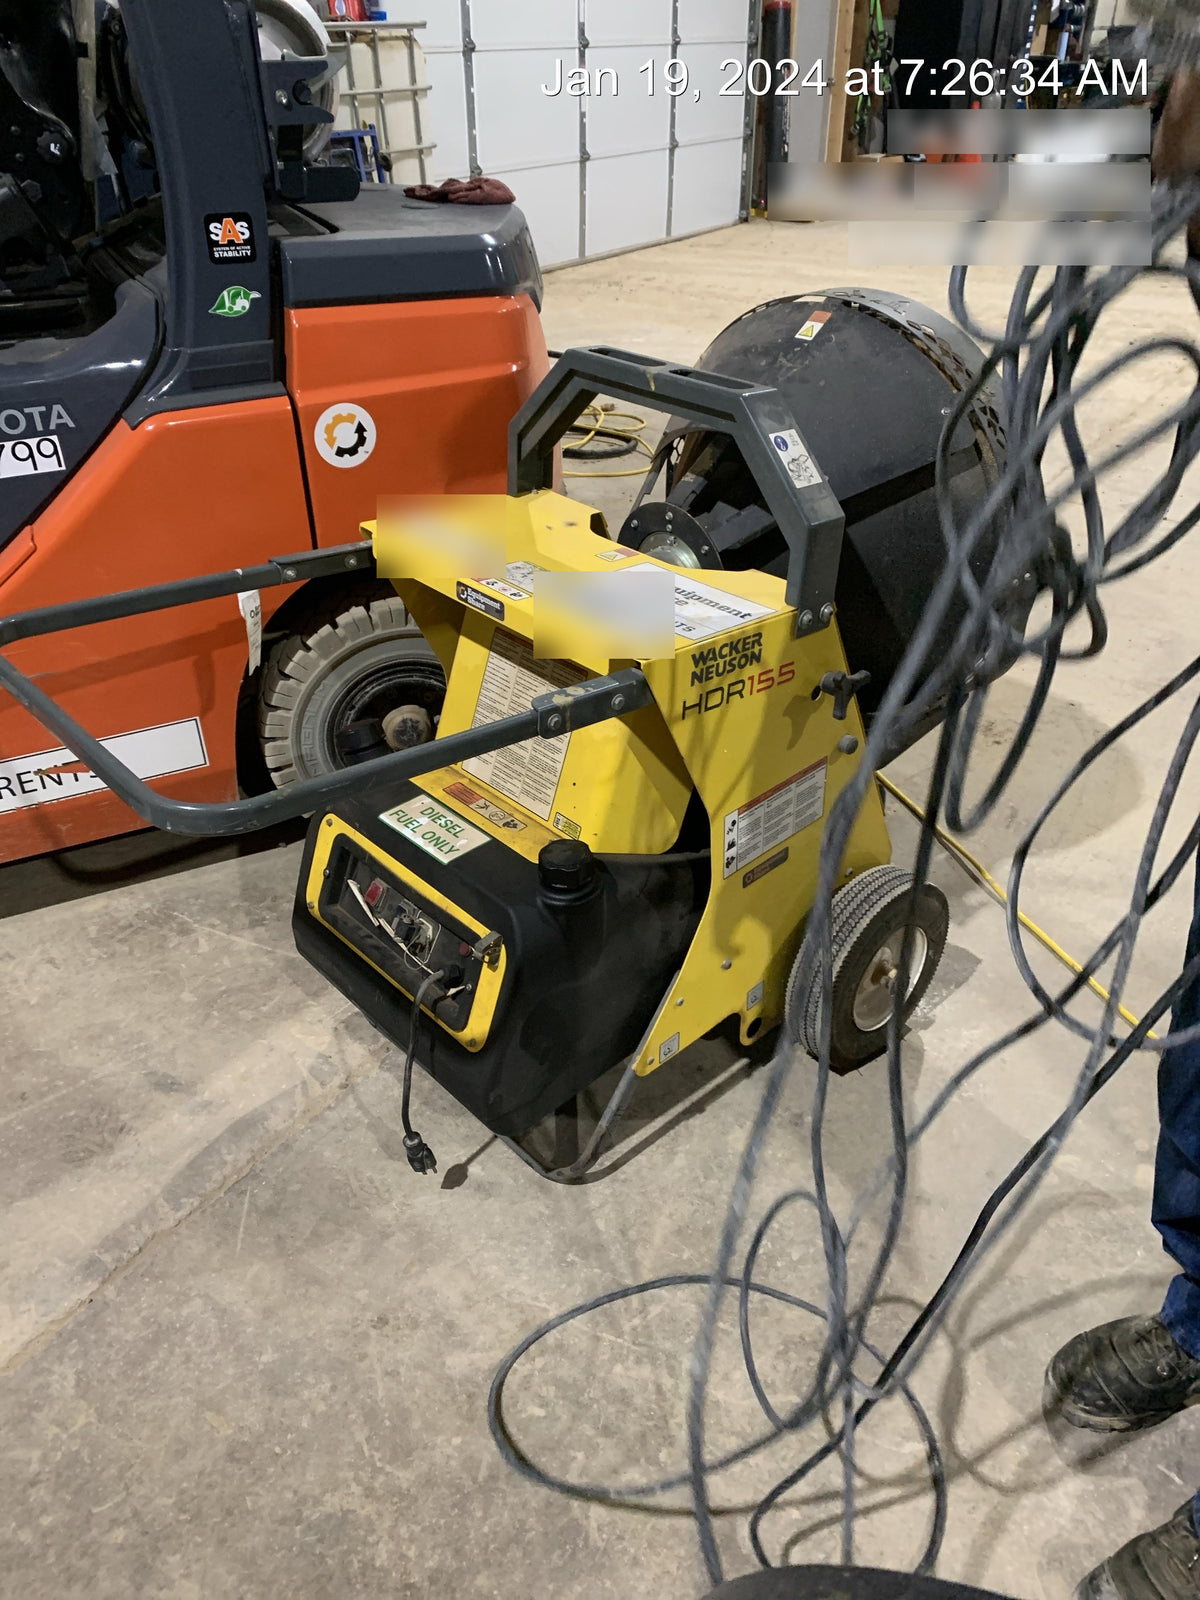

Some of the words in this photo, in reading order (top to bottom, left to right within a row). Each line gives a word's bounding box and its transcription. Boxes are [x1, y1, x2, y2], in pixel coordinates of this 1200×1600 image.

[209, 218, 250, 244] SAS
[214, 250, 251, 258] STABILITY
[0, 437, 63, 472] 99
[690, 648, 762, 687] NEUSON
[691, 632, 763, 669] WACKER
[682, 661, 796, 720] HDR155
[0, 760, 98, 800] RENT
[388, 809, 422, 834] FUEL
[421, 830, 461, 856] ONLY
[419, 806, 465, 839] DIESEL
